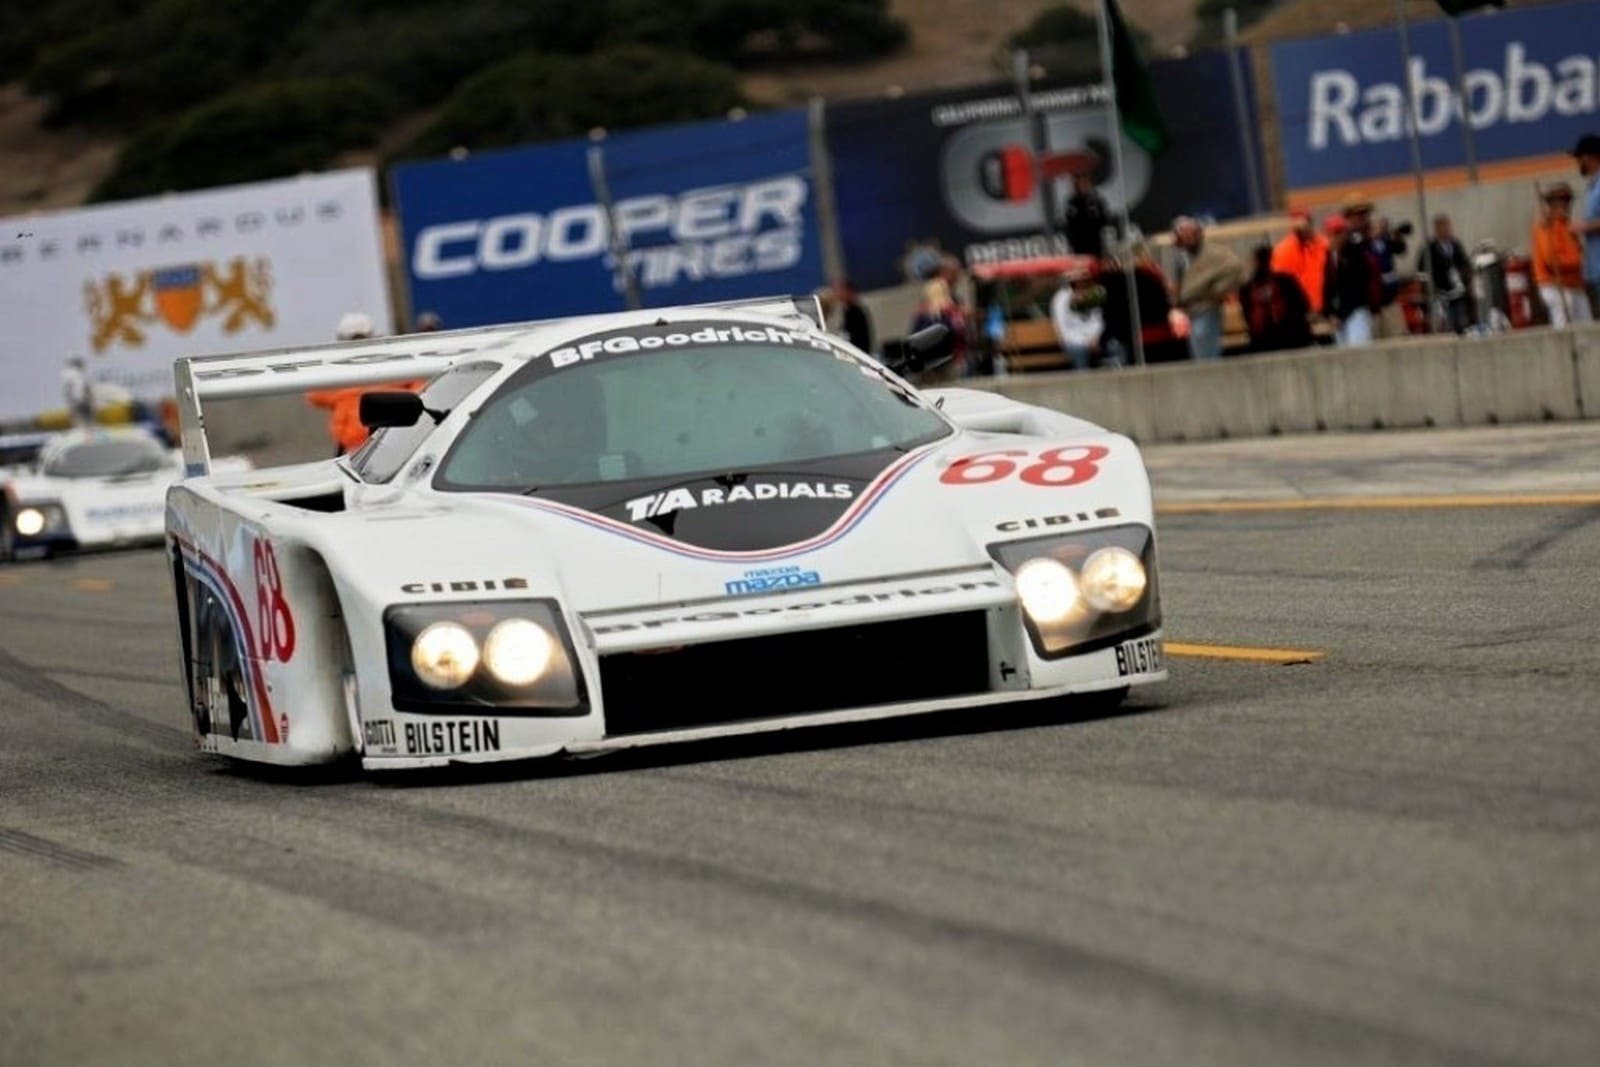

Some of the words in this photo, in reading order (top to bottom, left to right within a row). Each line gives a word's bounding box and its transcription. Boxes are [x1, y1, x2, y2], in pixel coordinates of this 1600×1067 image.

[1309, 42, 1600, 149] Raboba
[0, 201, 344, 262] BERNARDUS
[413, 176, 808, 280] COOPER
[605, 231, 803, 292] TIRES
[550, 327, 795, 368] BFGoodrich
[939, 445, 1111, 487] 68
[699, 482, 854, 507] RADIALS
[995, 507, 1121, 532] CIBIE
[253, 537, 296, 664] 68
[401, 577, 529, 595] CIBIE
[725, 570, 821, 595] mazda
[405, 719, 501, 755] BILSTEIN
